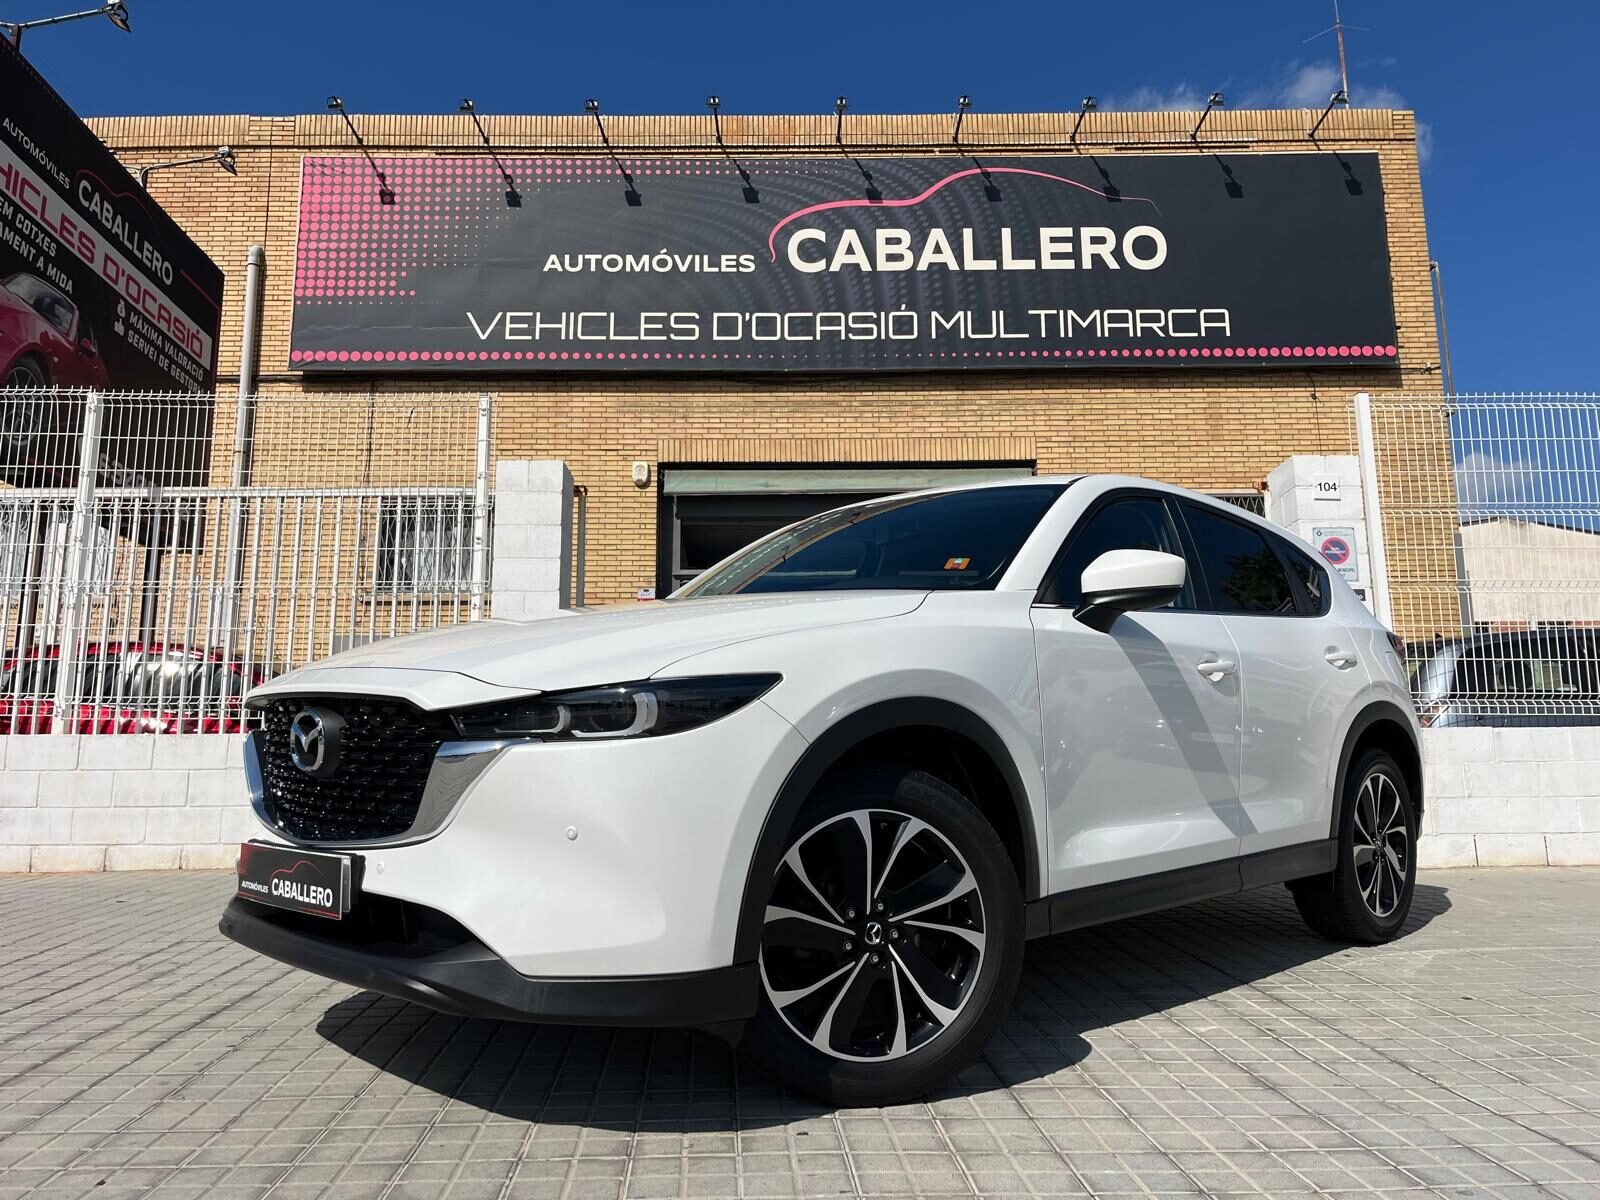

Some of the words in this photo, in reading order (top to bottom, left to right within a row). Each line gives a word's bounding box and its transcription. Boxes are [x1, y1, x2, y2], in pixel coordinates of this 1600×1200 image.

[3, 117, 70, 189] AUTOMÓVILES
[15, 213, 57, 257] COTXES
[78, 179, 173, 286] CABALLERO
[542, 248, 756, 273] AUTOMÓVILES
[786, 225, 1168, 273] CABALLERO
[36, 255, 44, 271] A
[47, 263, 73, 294] MIDA
[466, 311, 700, 341] VEHICLES
[713, 304, 918, 341] D'OCASIÓ
[931, 308, 1231, 339] MULTIMARCA
[127, 330, 157, 362] SERVEI
[158, 355, 169, 372] DE
[1317, 482, 1338, 492] 104
[271, 878, 333, 908] CABALLERO
